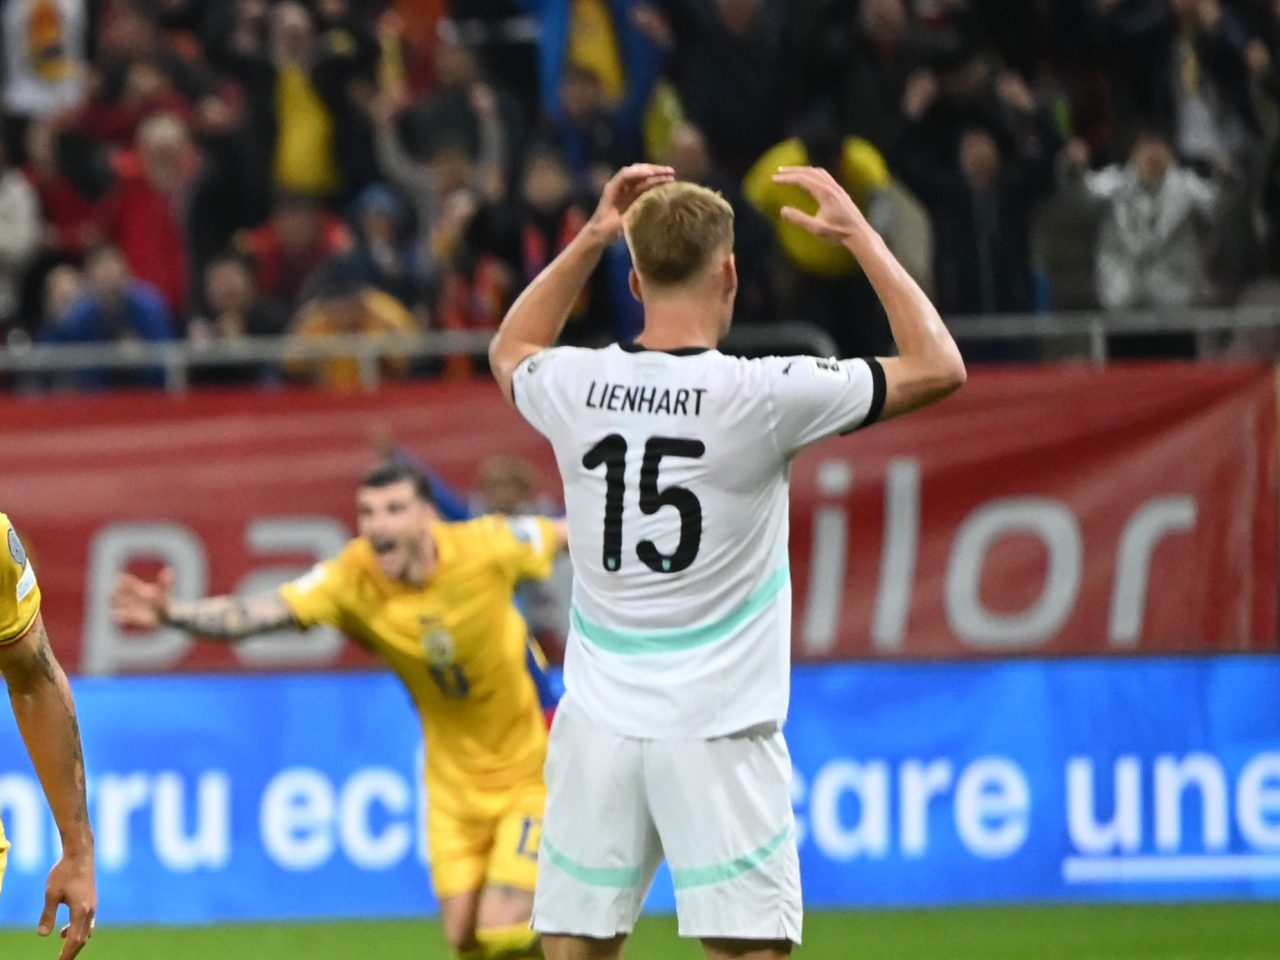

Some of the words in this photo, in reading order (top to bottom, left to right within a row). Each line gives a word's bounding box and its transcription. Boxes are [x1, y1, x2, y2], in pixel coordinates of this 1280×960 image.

[585, 381, 707, 416] LIENHART
[582, 433, 706, 573] 15
[789, 756, 1032, 862] are
